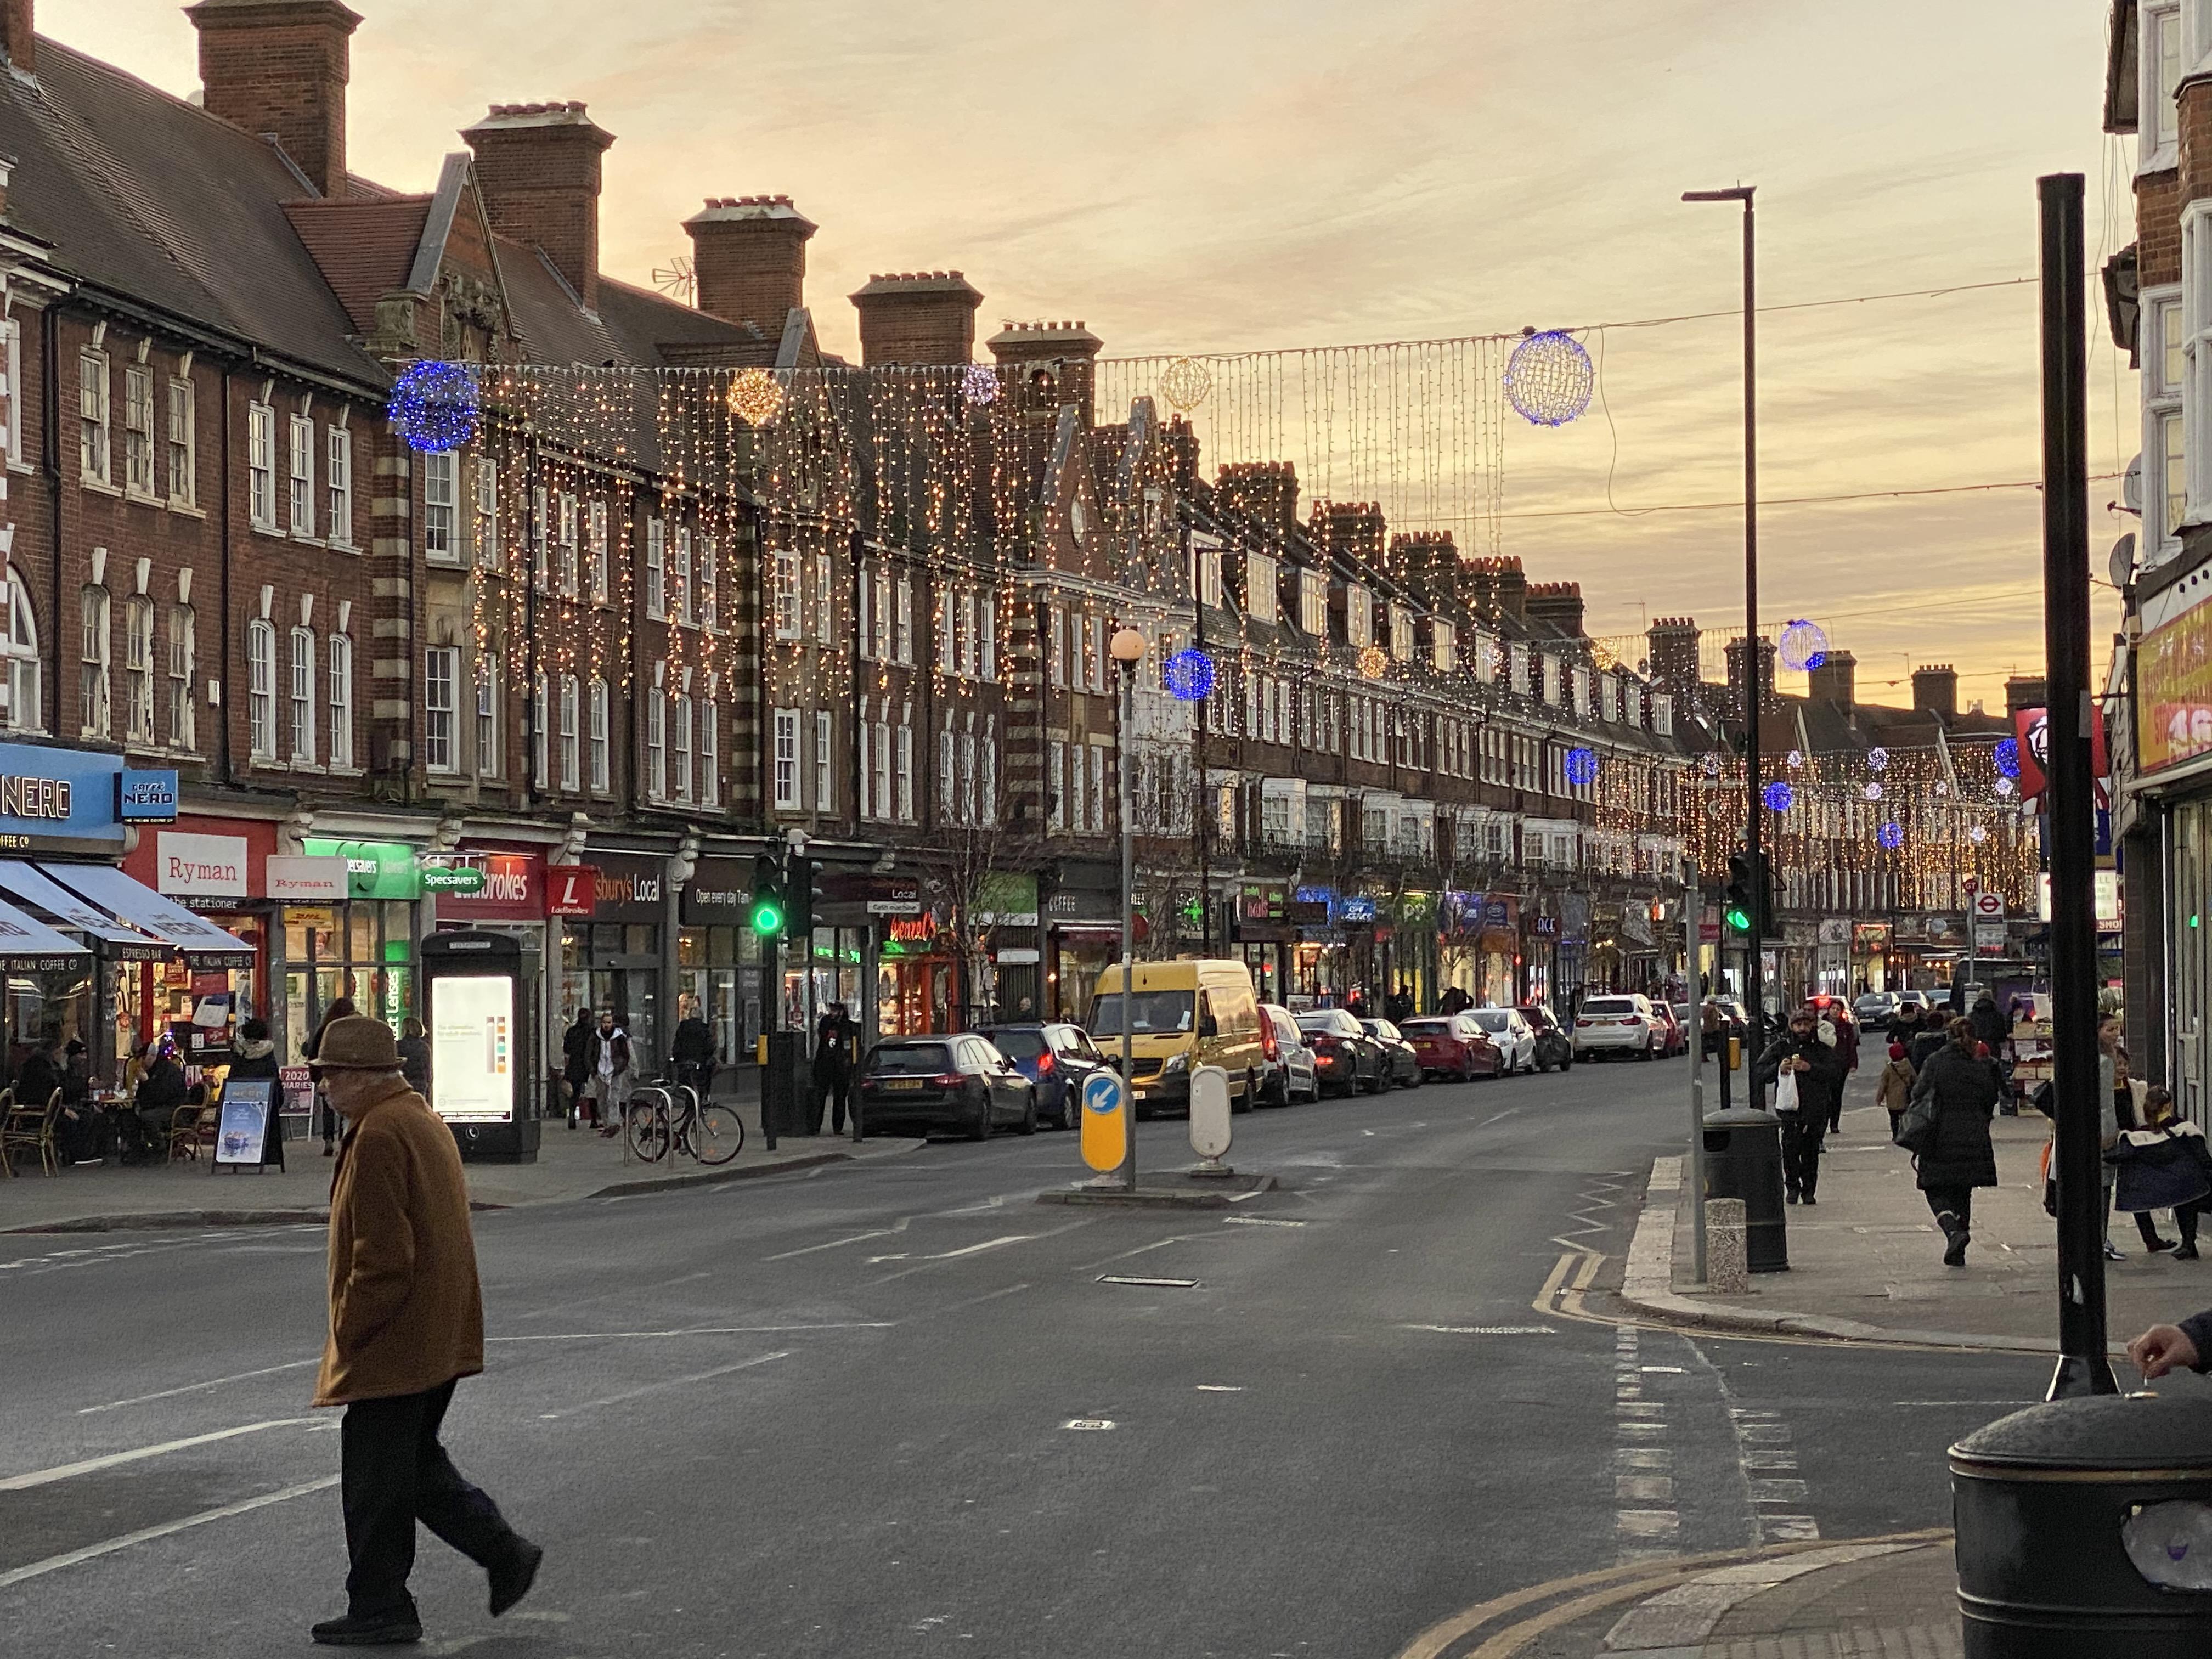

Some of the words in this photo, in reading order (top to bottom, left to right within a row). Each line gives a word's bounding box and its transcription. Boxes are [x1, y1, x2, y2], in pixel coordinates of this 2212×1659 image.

[1, 774, 72, 819] NERO
[125, 793, 174, 805] NERO
[0, 834, 16, 848] FFEE
[168, 856, 238, 883] Ryman
[275, 879, 334, 888] Ryman
[424, 873, 478, 887] Specsavers
[454, 861, 528, 900] brokes
[562, 877, 579, 904] L
[595, 872, 633, 907] sbury's
[634, 873, 660, 901] Local
[892, 889, 916, 899] Local
[189, 898, 238, 909] stationer
[40, 960, 65, 971] COFFEE
[285, 1071, 309, 1081] 2020
